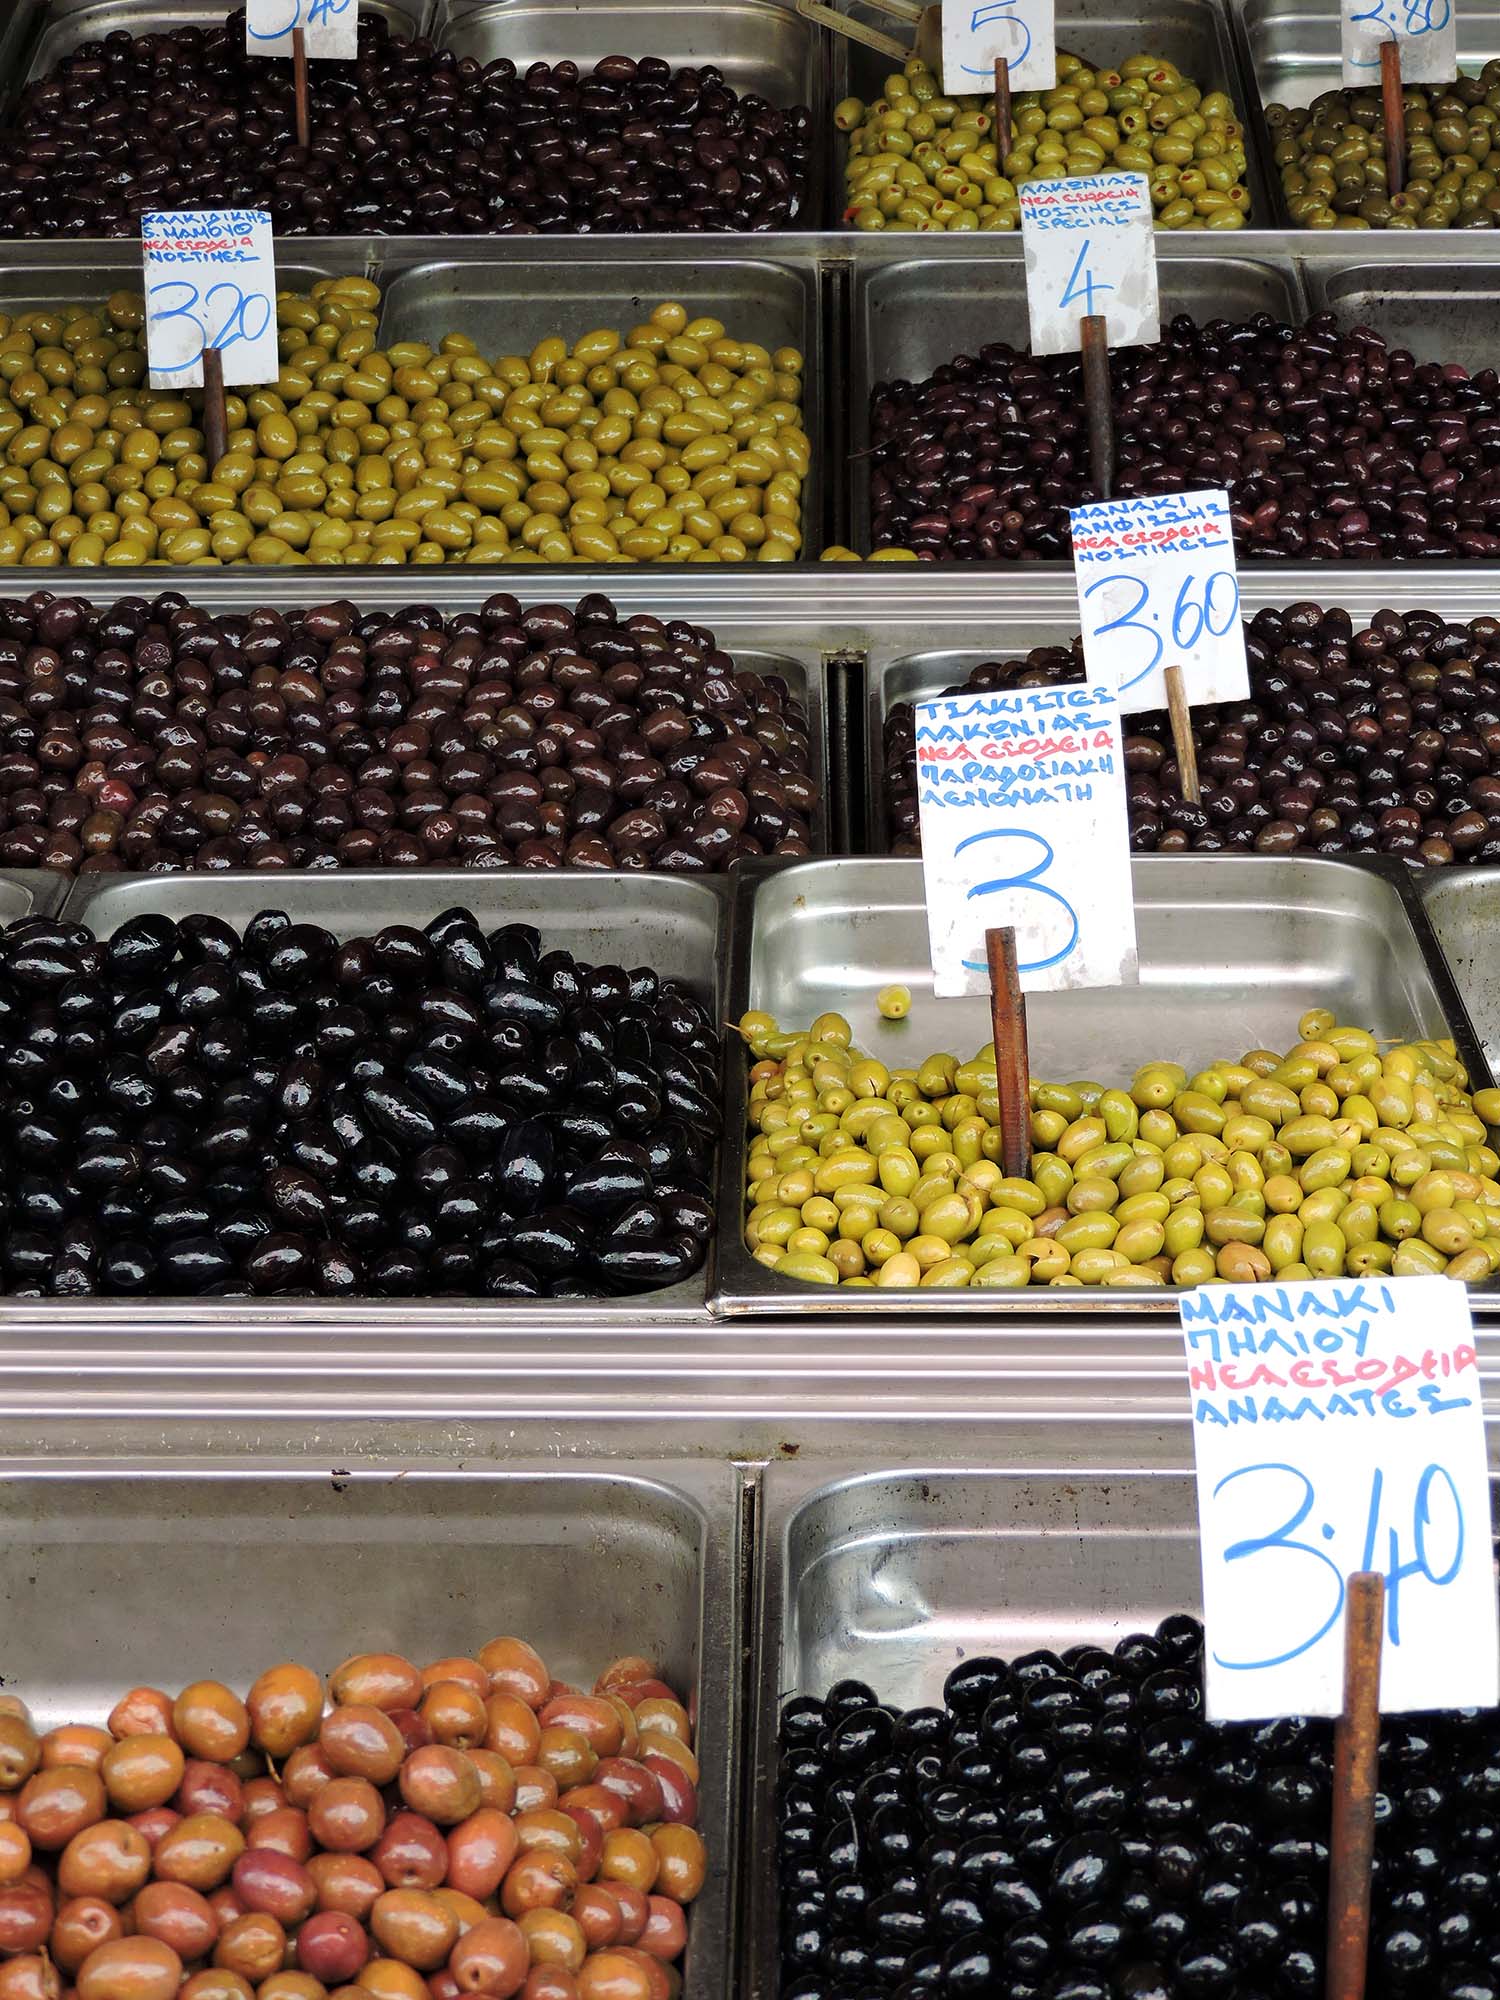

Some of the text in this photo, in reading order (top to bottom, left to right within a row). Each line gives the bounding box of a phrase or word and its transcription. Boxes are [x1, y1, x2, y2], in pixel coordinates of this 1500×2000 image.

[960, 0, 1031, 75] 5
[1059, 240, 1114, 315] 4
[1084, 571, 1239, 692] 3.60
[954, 828, 1079, 974] 3
[1212, 1462, 1466, 1670] 3.40
